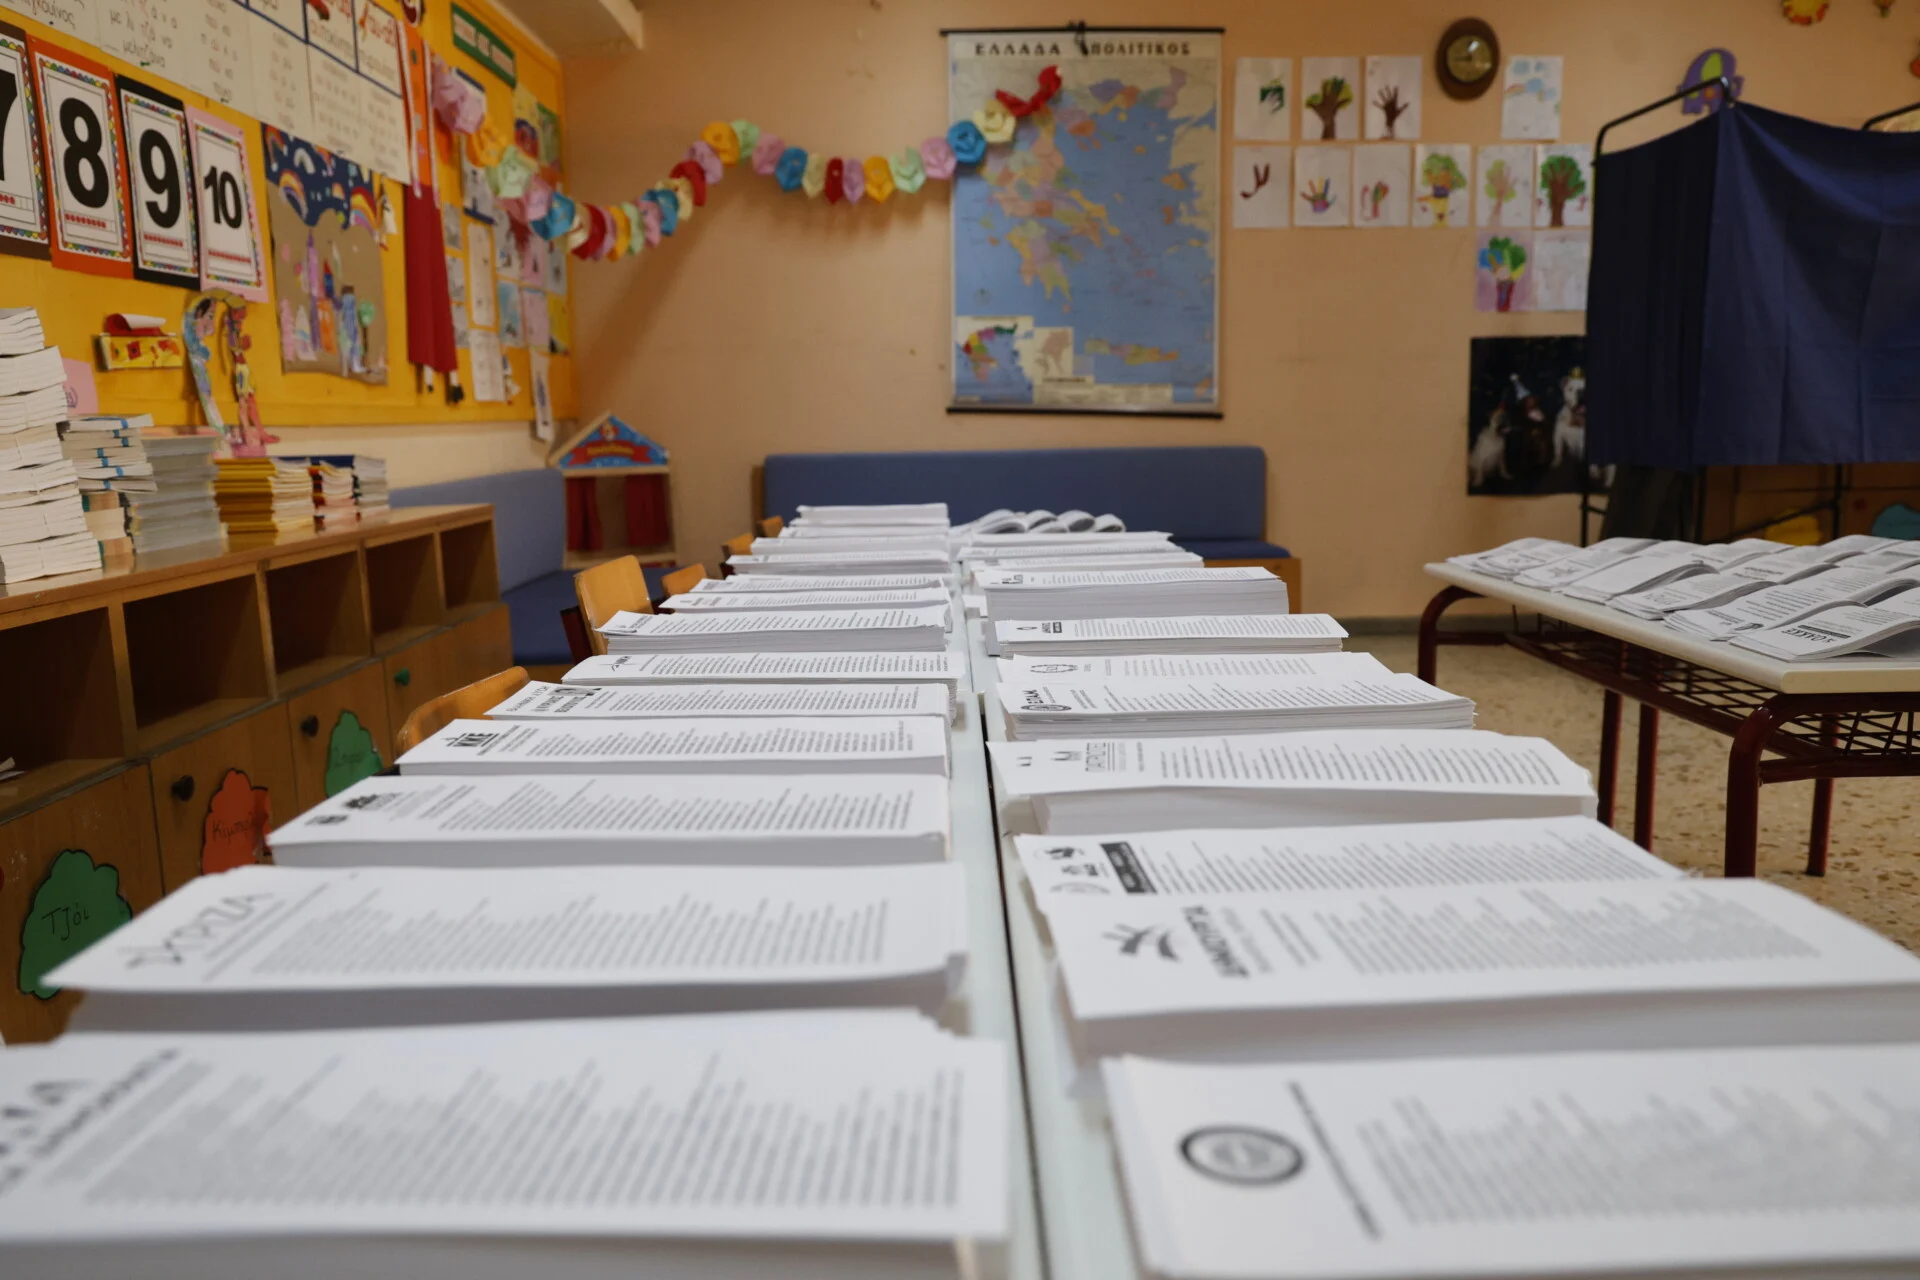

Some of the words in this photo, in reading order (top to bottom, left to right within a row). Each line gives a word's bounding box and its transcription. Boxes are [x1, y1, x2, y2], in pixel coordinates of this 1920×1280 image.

[975, 41, 1061, 57] ΕΛΛΑΔΑ
[1091, 41, 1190, 57] ΠΟΛΙΤΙΚΟΣ
[59, 97, 110, 209] 8
[139, 128, 182, 229] 9
[204, 165, 243, 229] 10
[452, 732, 496, 748] ΚΚΕ
